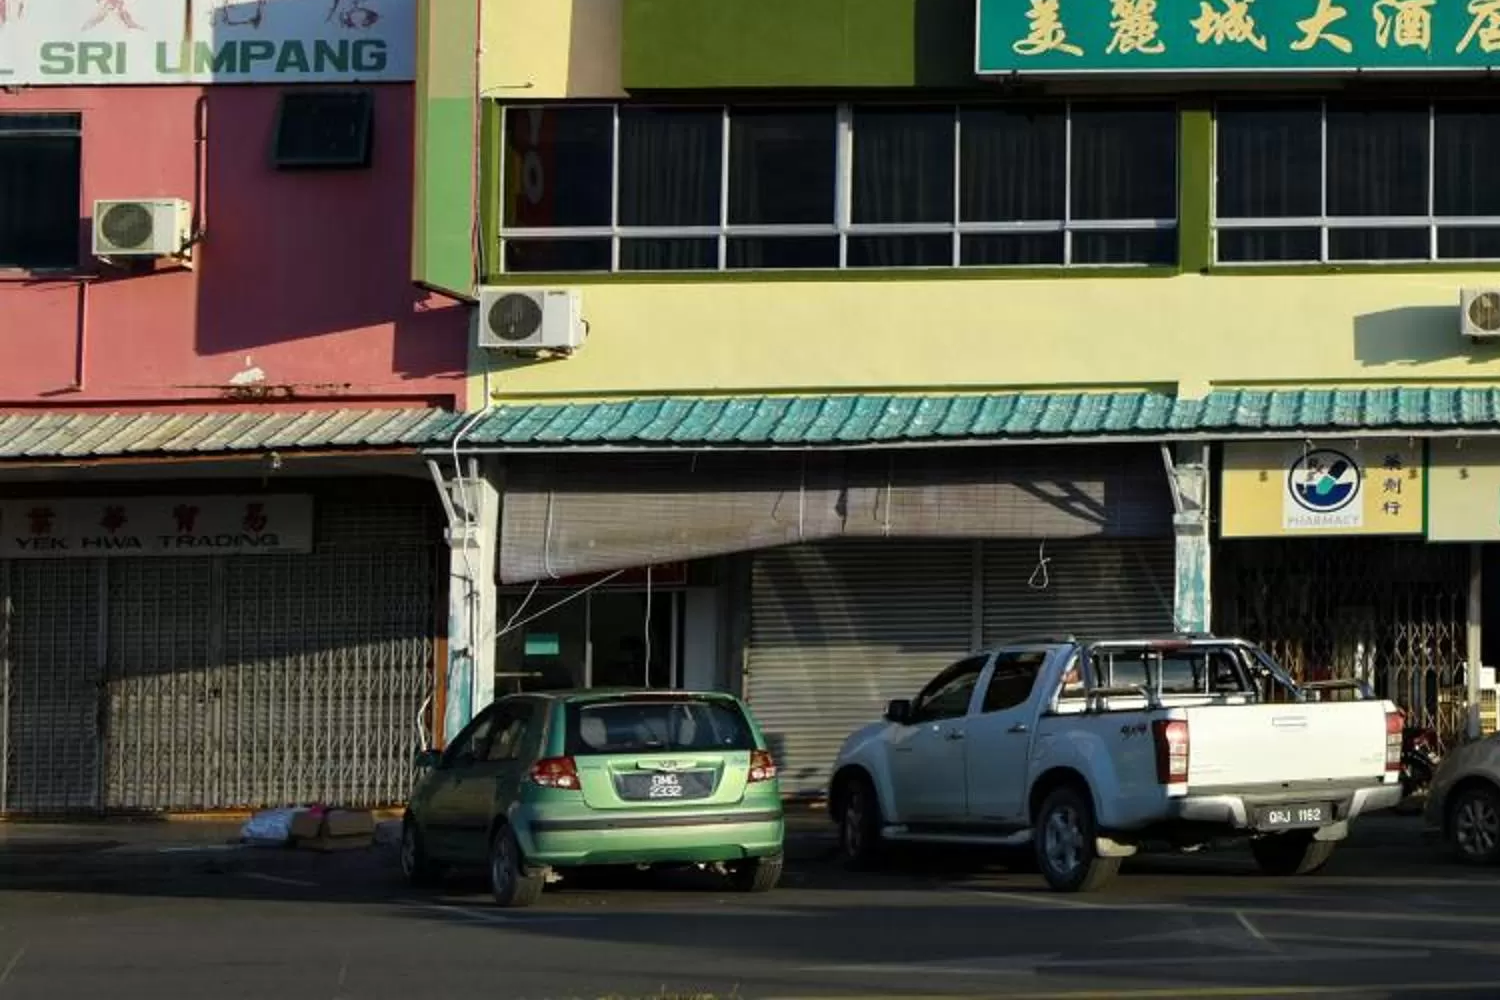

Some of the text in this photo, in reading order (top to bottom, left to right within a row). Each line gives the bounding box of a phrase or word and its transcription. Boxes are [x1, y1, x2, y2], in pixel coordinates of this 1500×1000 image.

[40, 39, 388, 75] SRI UMPANG
[1288, 514, 1359, 526] PHARMACY
[15, 533, 281, 549] YEK HWA TRADING
